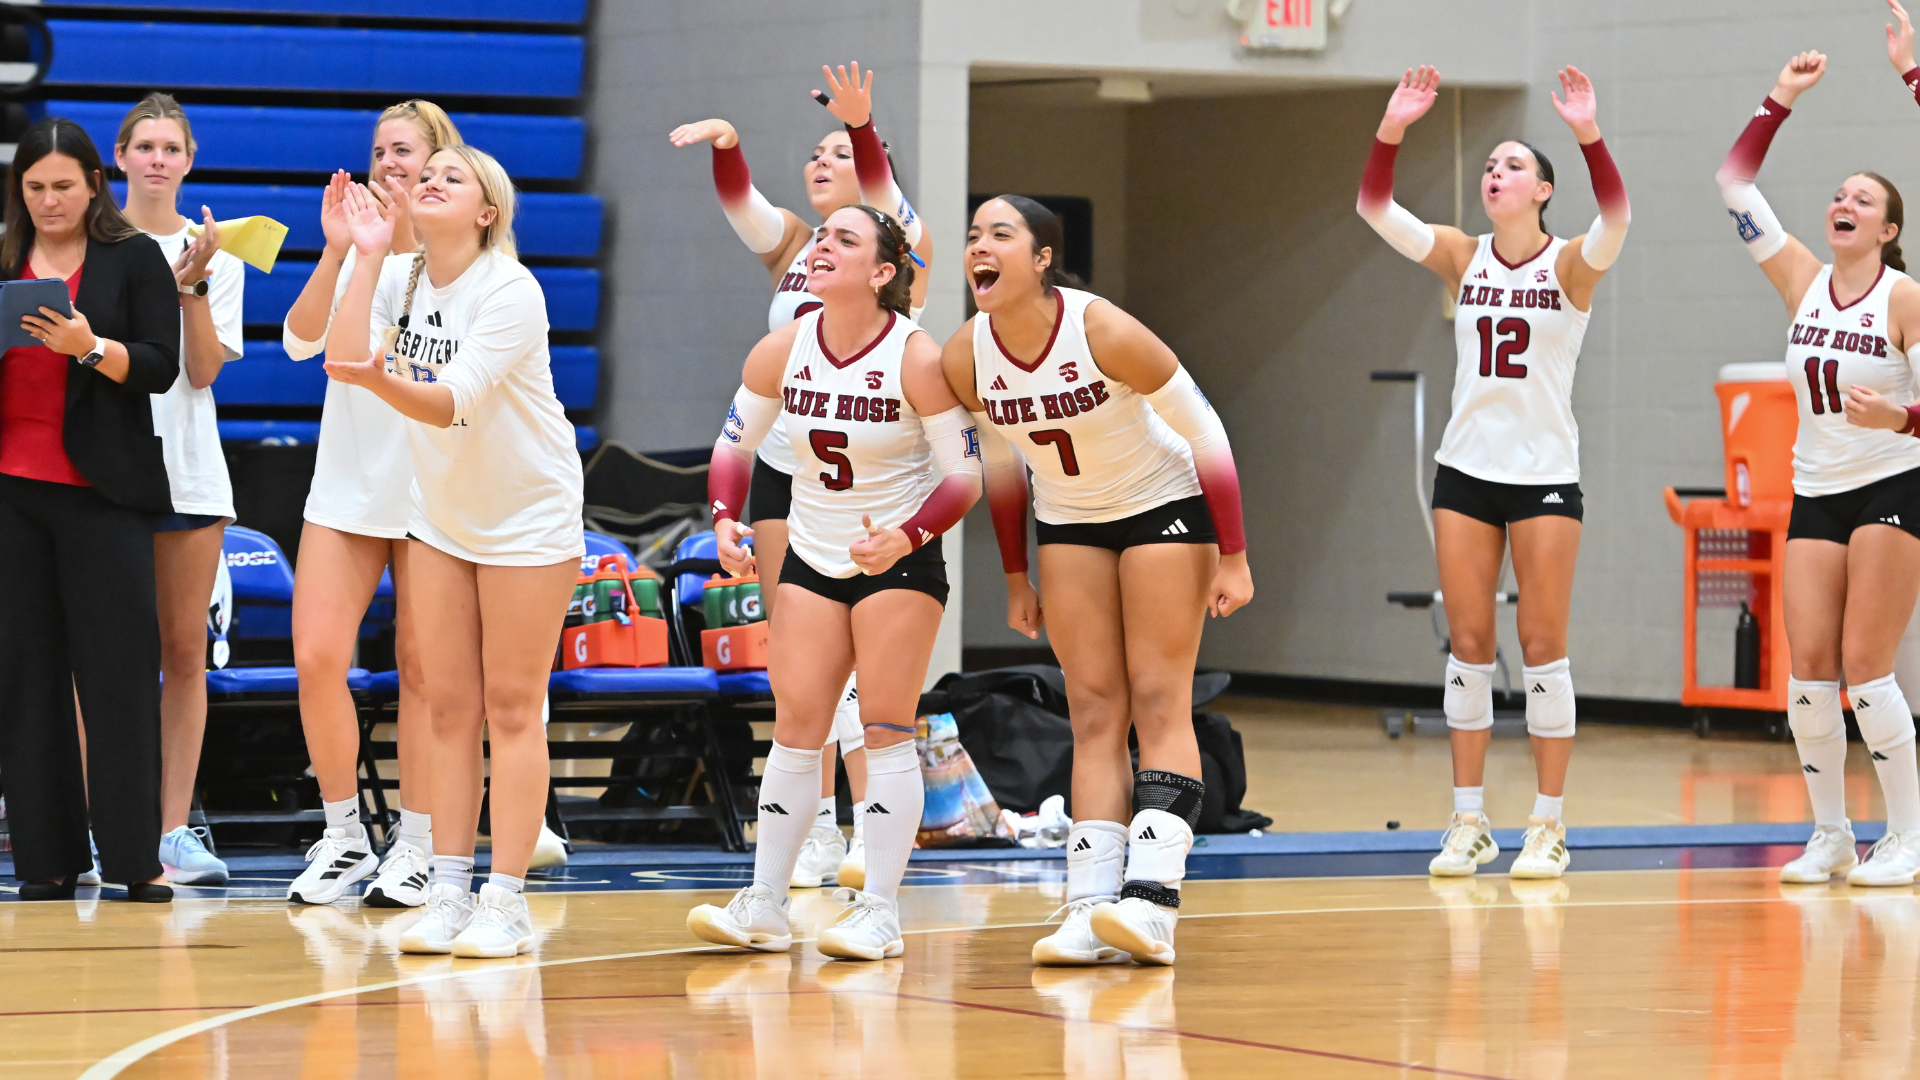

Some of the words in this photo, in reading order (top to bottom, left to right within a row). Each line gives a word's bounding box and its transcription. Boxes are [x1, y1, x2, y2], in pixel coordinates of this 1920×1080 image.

[1509, 289, 1561, 311] HOSE
[1477, 316, 1530, 379] 12
[1830, 330, 1888, 358] HOSE
[1040, 380, 1110, 420] HOSE
[1804, 356, 1843, 415] 11
[835, 394, 900, 422] HOSE
[809, 429, 854, 491] 5
[1028, 429, 1080, 477] 7
[741, 595, 760, 617] G
[575, 632, 588, 662] G
[717, 635, 731, 665] G
